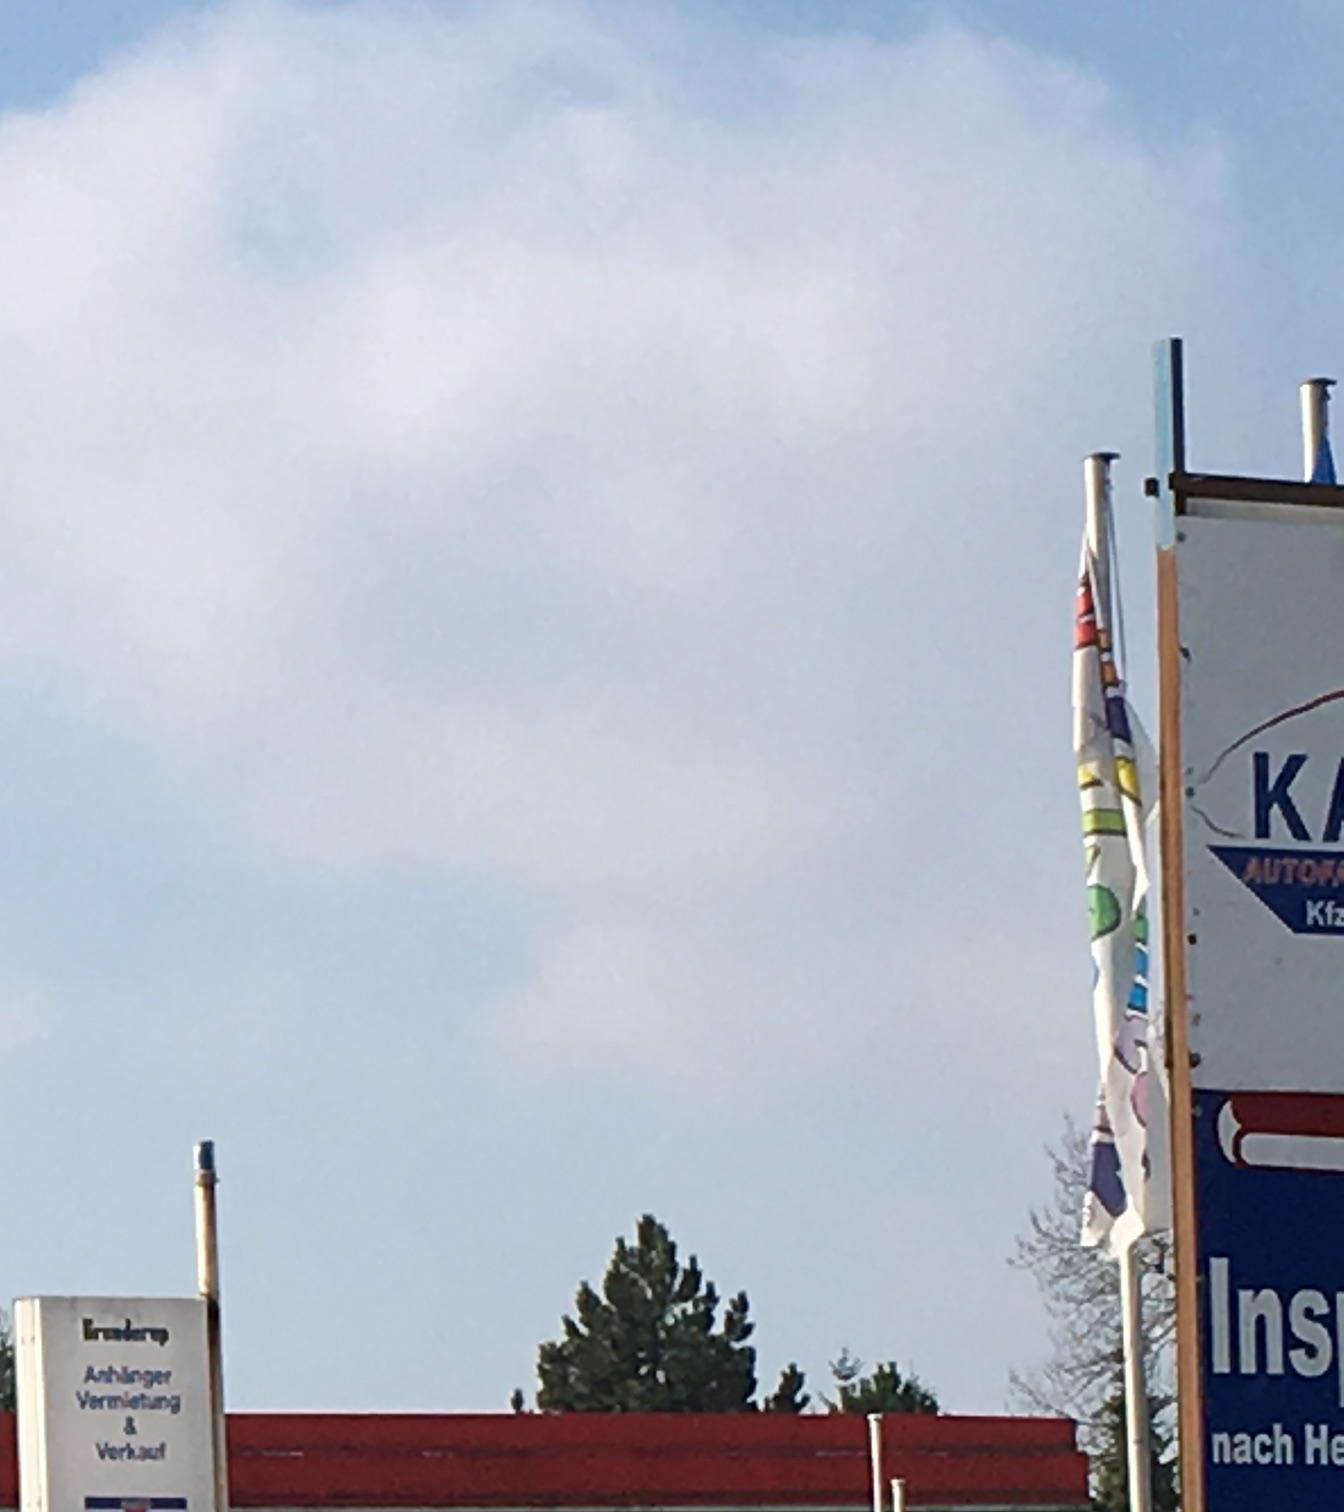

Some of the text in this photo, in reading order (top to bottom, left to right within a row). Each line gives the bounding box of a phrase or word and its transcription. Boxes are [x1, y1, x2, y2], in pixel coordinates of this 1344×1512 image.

[76, 1391, 181, 1414] Vermietung
[123, 1416, 137, 1435] &
[96, 1441, 166, 1461] Verkauf
[1212, 1423, 1294, 1465] nach
